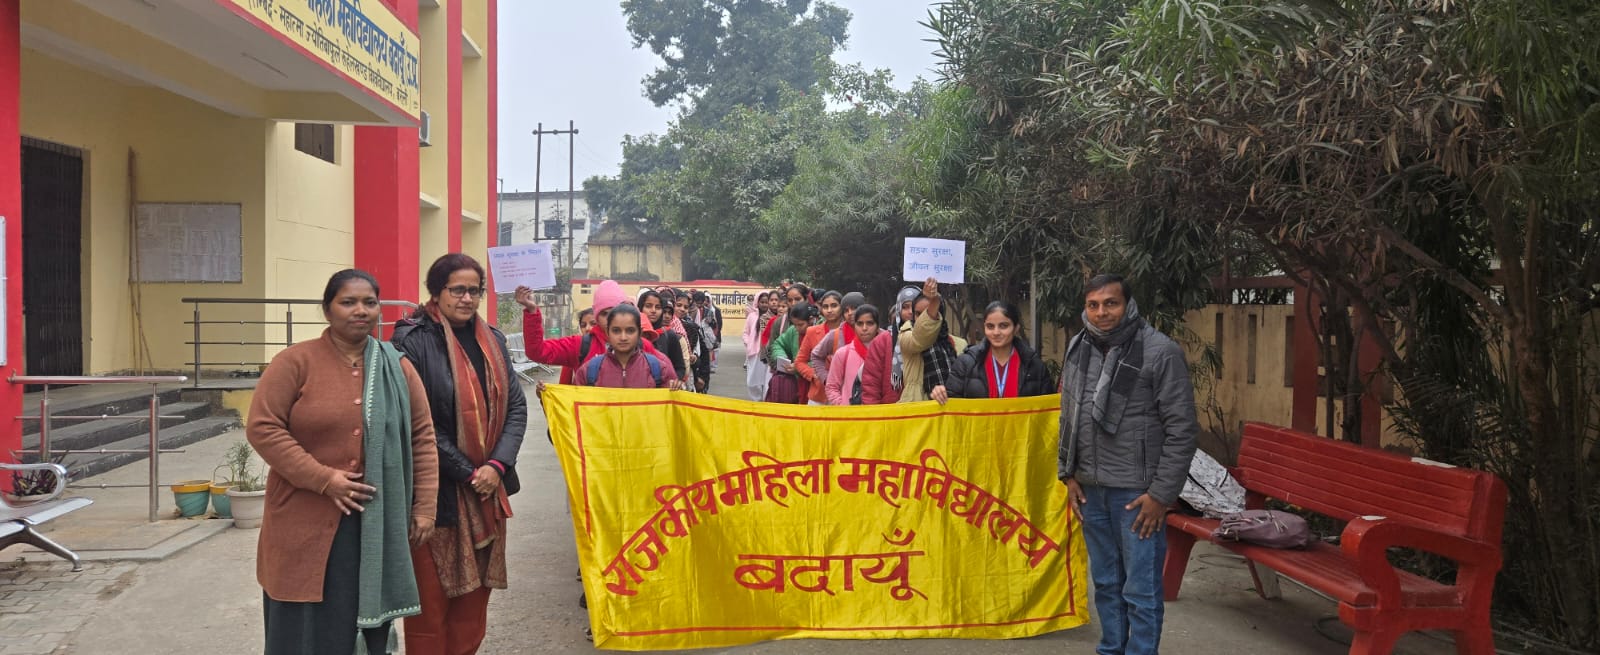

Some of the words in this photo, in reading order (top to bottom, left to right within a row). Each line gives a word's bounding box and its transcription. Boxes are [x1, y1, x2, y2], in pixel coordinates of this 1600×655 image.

[279, 5, 304, 38] महात्मा
[602, 480, 717, 597] राजकीय
[718, 450, 835, 508] महिला
[837, 448, 1060, 569] महाविद्यालय
[733, 527, 928, 601] बदायूँ
